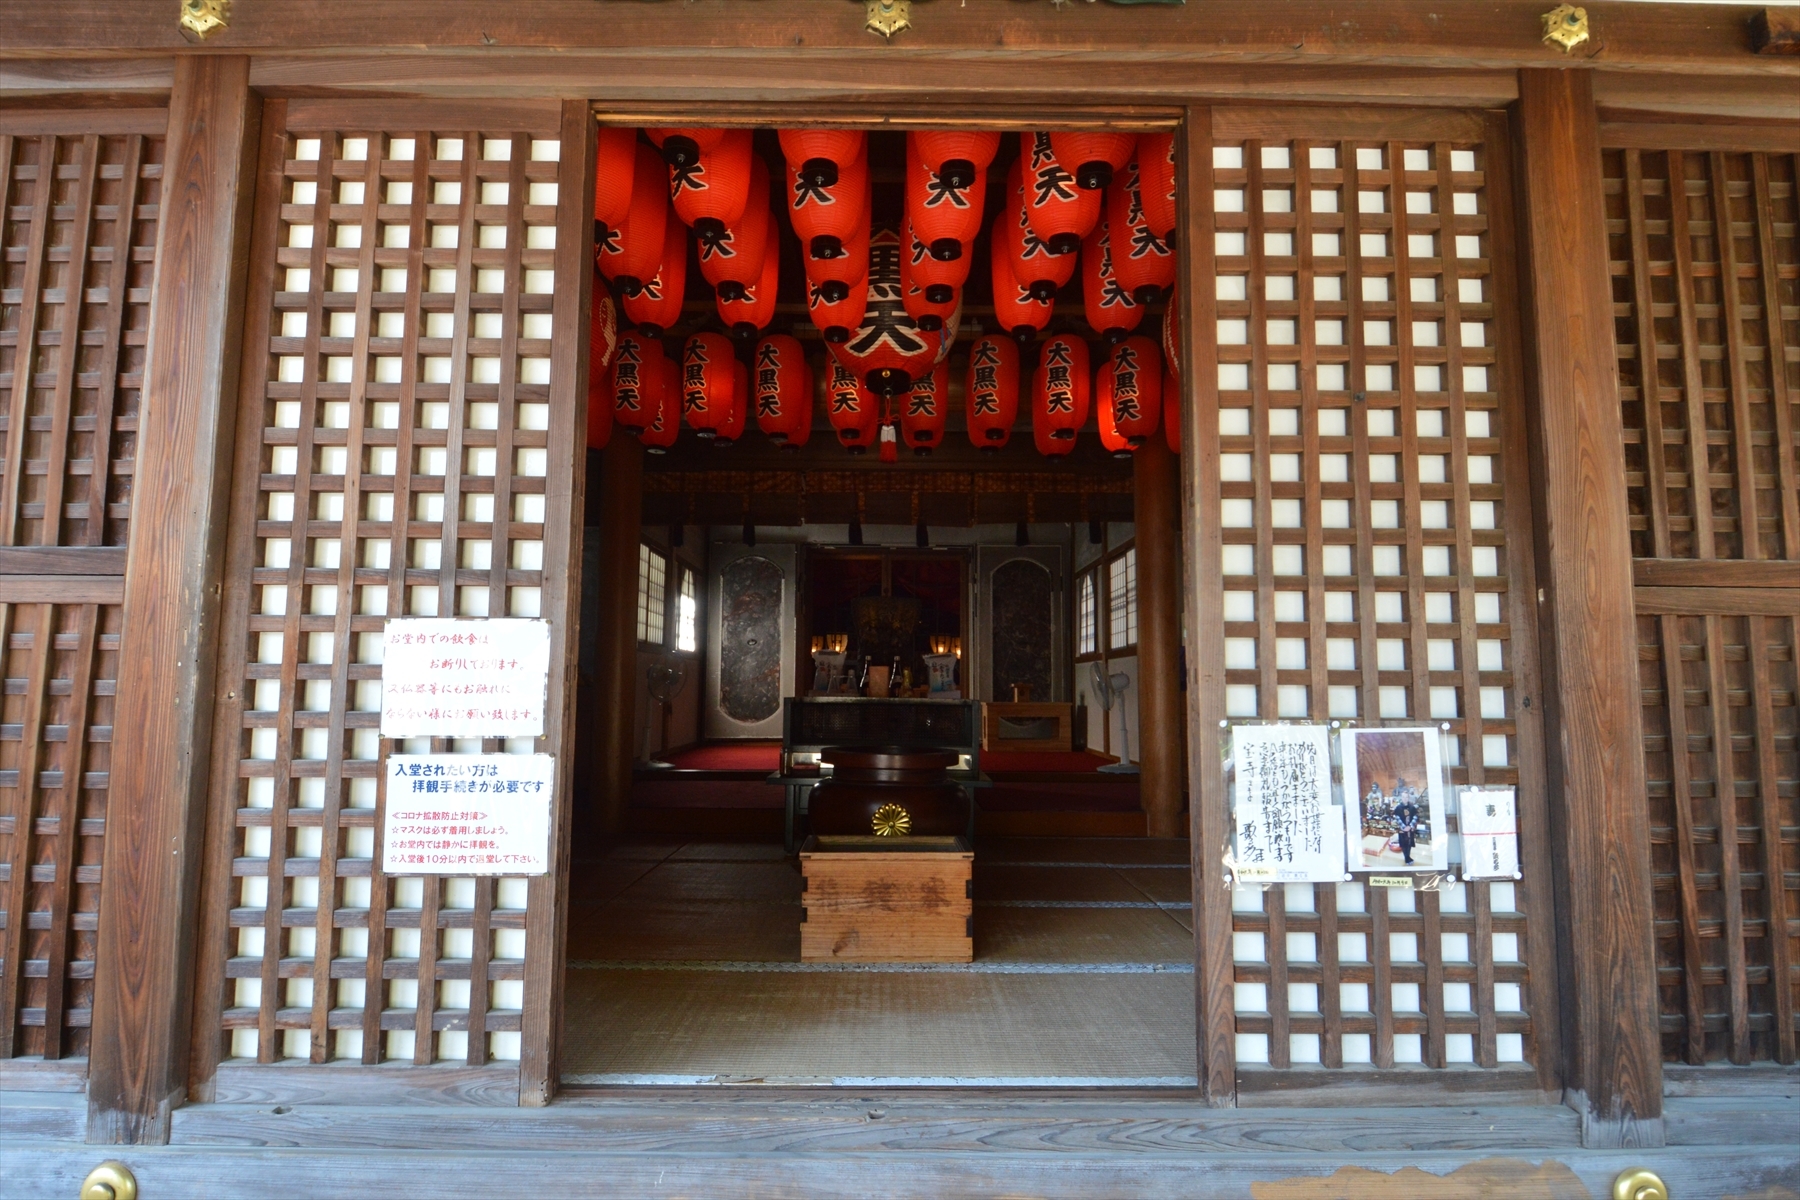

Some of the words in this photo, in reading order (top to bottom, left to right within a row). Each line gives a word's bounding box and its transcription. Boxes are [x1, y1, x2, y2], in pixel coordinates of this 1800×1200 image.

[615, 337, 642, 412] 大黒天
[684, 337, 710, 414] 大黒天
[756, 343, 783, 418] 大黒天
[972, 341, 1002, 416] 大黒天
[1045, 341, 1074, 414] 大黒天
[1112, 346, 1143, 423] 大黒天
[390, 632, 489, 645] お堂内での飲食は
[395, 764, 499, 777] 入堂されたい方は
[412, 780, 544, 793] 拝観手続きが必要です
